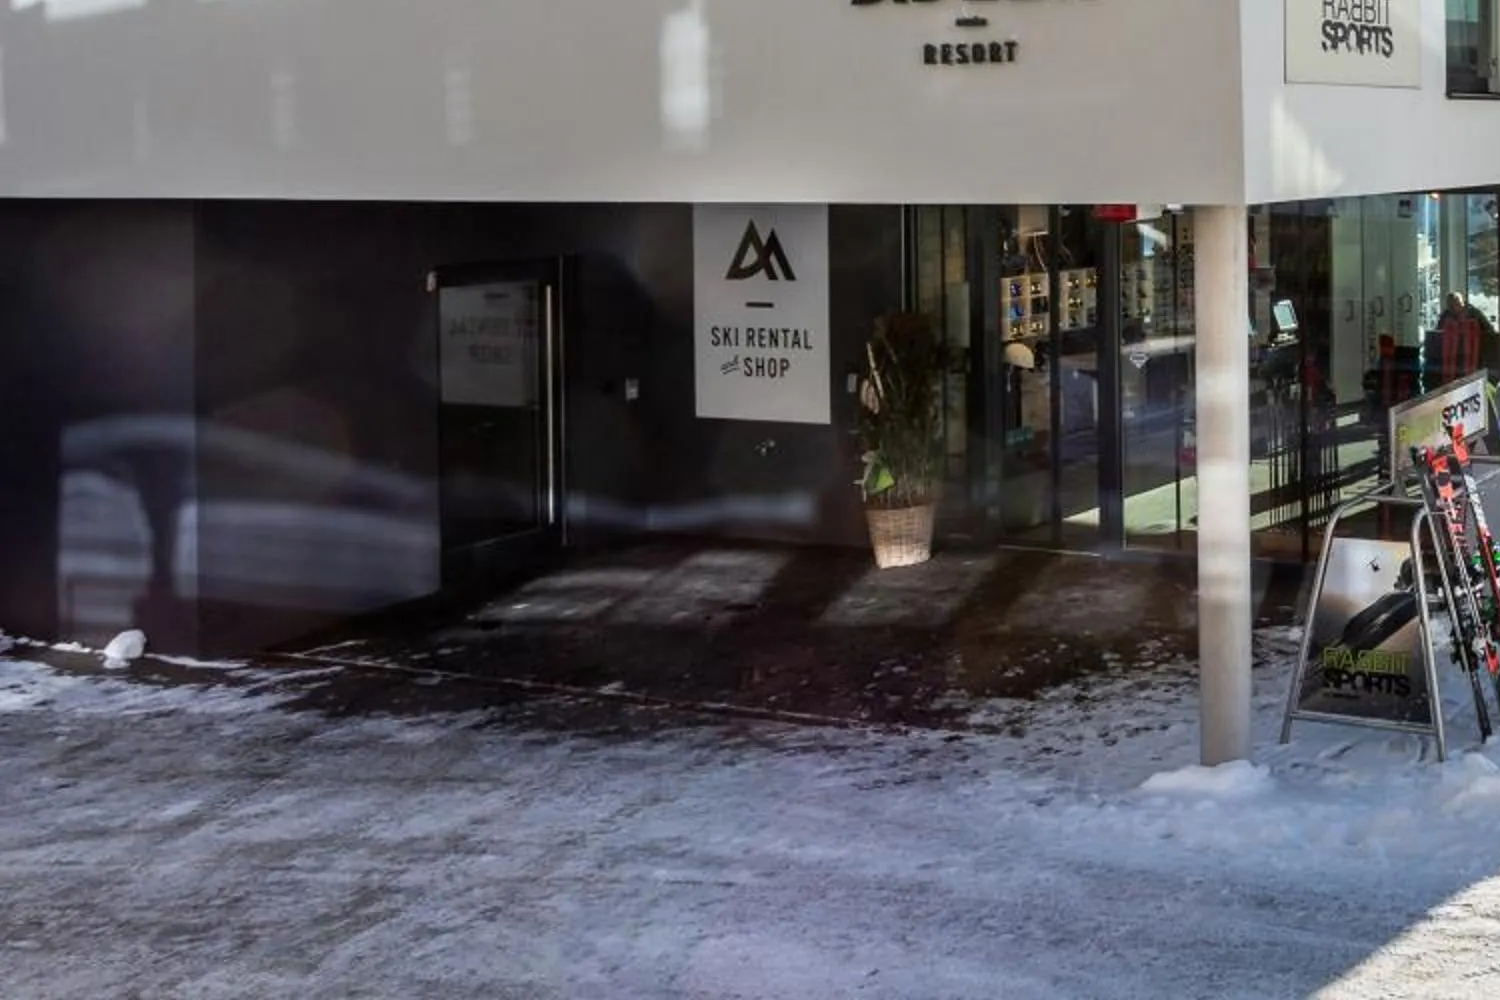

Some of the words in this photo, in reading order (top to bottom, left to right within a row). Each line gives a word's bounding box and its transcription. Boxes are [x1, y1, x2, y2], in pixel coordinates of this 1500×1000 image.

[1321, 19, 1394, 58] SPORTS
[923, 40, 1018, 66] RESORT
[711, 326, 739, 347] SKI
[745, 327, 813, 350] RENTAL
[743, 357, 790, 379] SHOP
[1323, 668, 1412, 697] SPORTS
